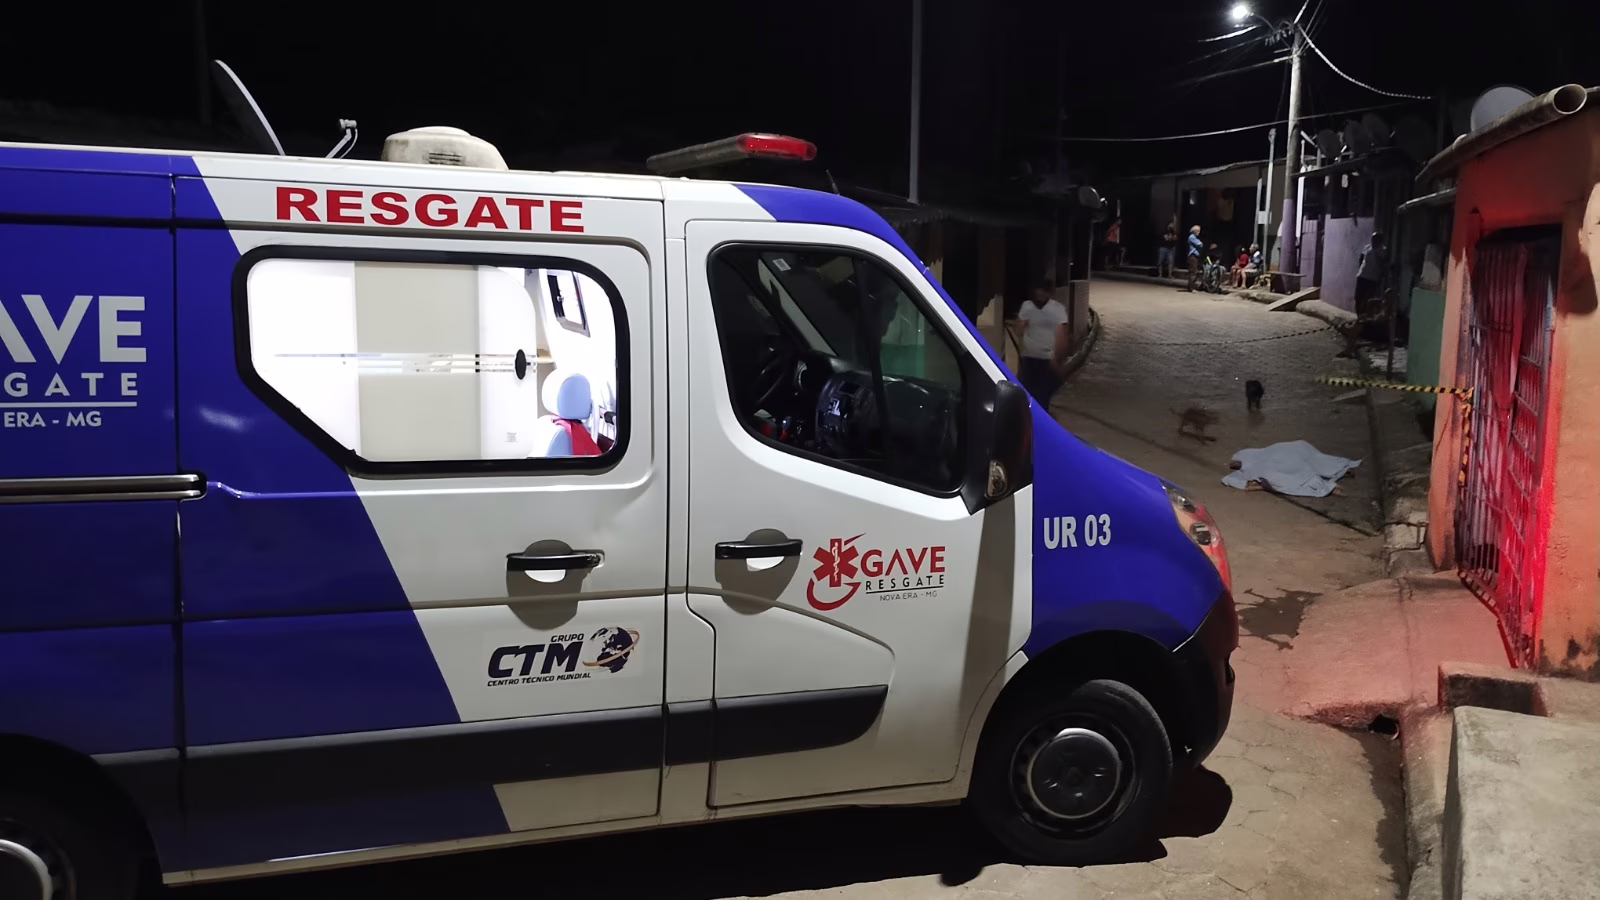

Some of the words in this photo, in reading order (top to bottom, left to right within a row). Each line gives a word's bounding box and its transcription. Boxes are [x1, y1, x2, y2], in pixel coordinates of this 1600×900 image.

[276, 186, 585, 233] RESGATE
[4, 412, 46, 427] ERA
[66, 411, 102, 427] MG
[1043, 516, 1078, 550] UR
[1084, 513, 1112, 547] 03
[860, 546, 946, 577] GAVE
[865, 575, 945, 591] RESGATE
[880, 593, 901, 602] NOVA
[925, 590, 937, 598] MG
[550, 633, 585, 643] GRUPO
[488, 641, 583, 679] CTM
[487, 678, 519, 687] CENTRO
[556, 672, 592, 681] MUNDIAL
